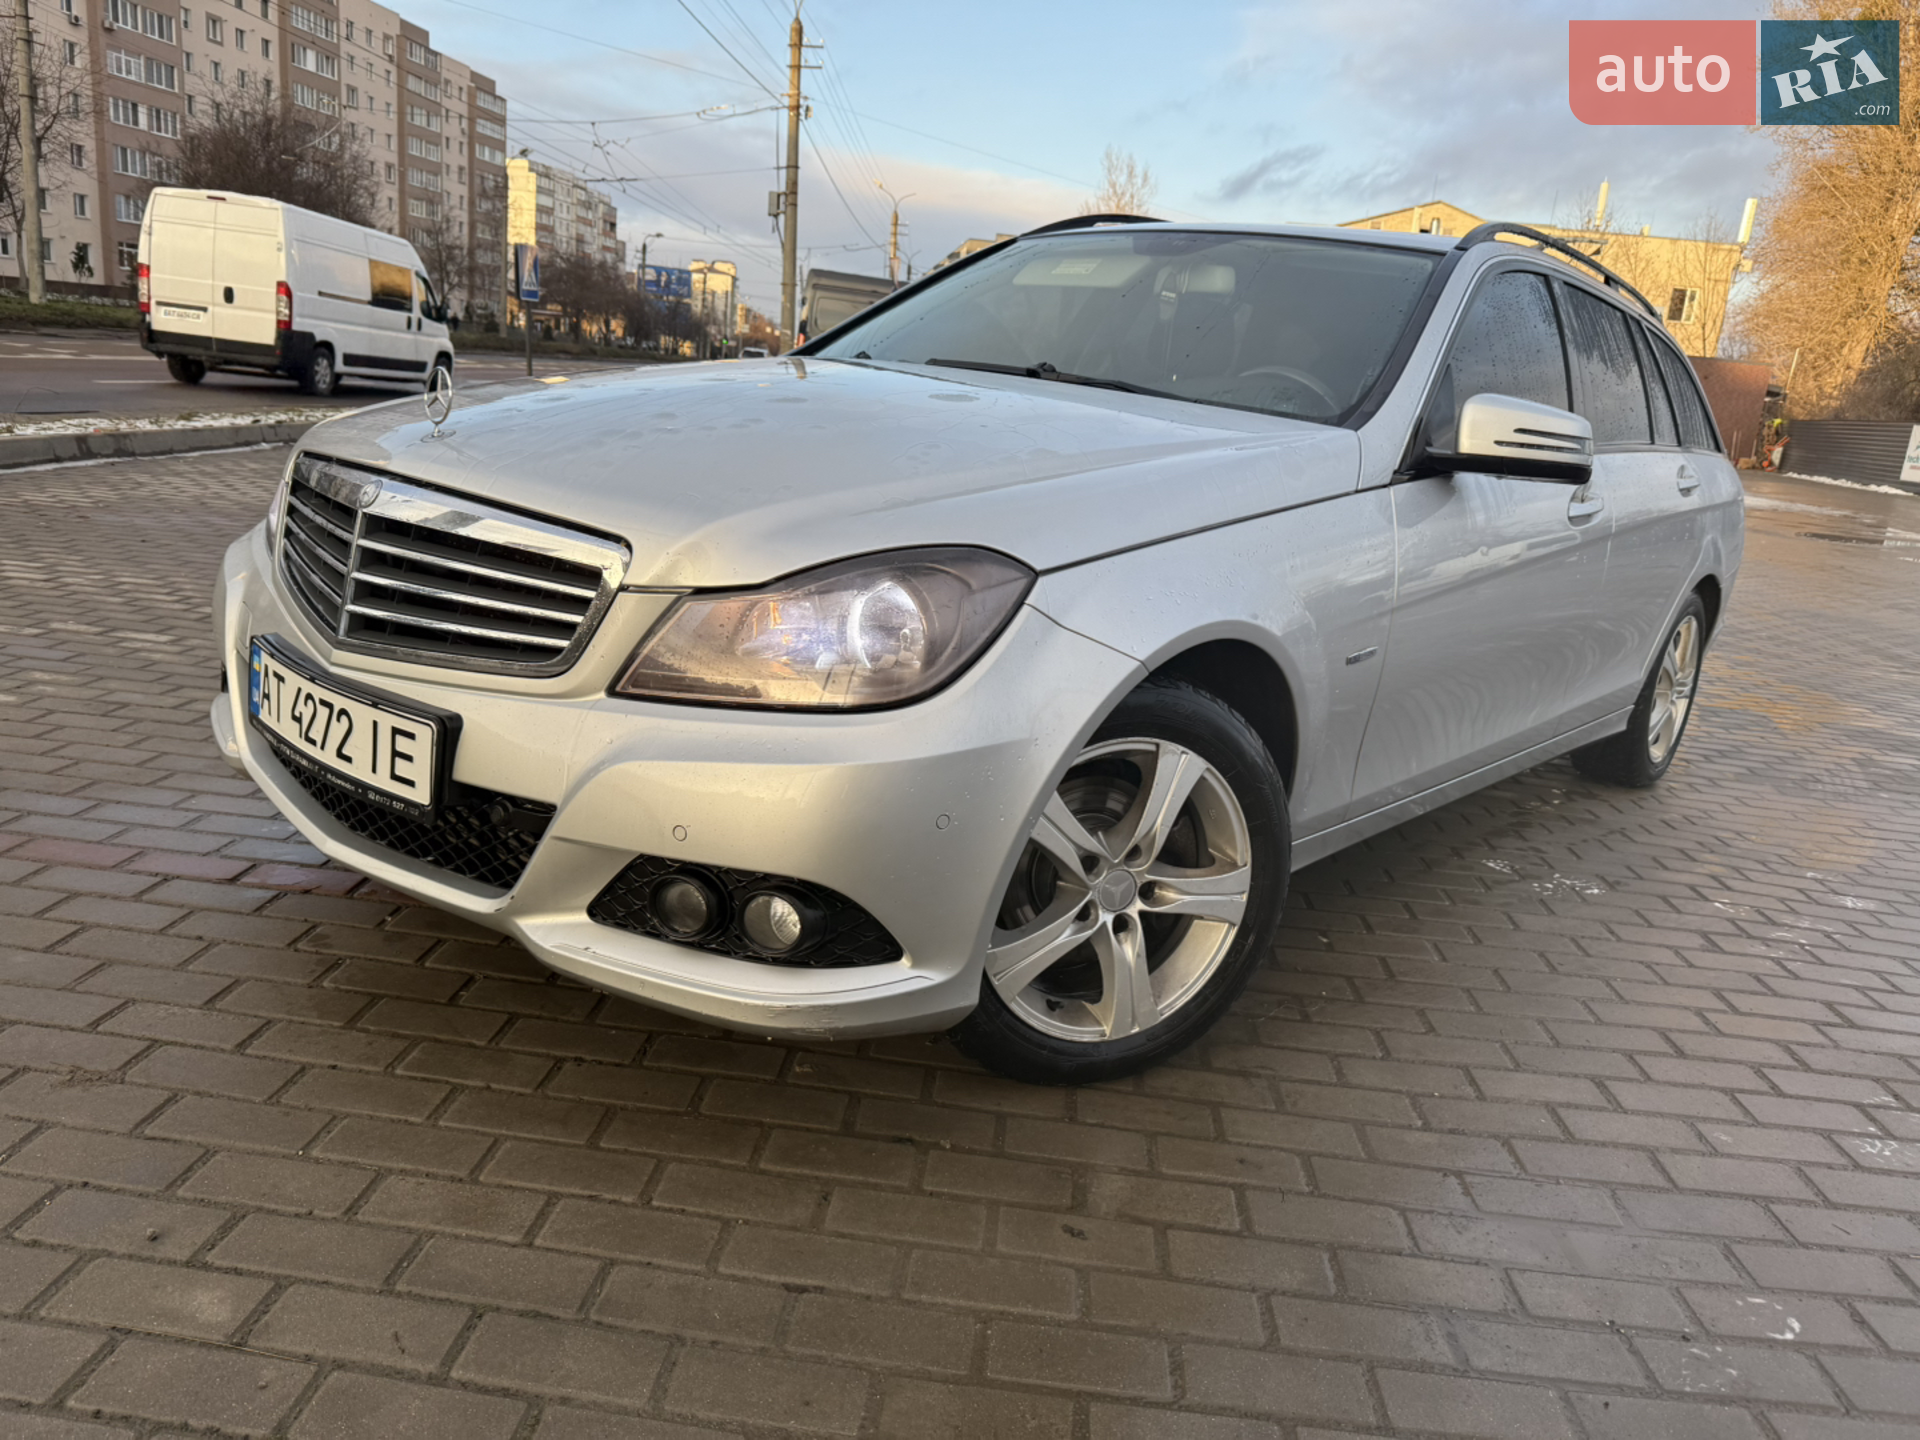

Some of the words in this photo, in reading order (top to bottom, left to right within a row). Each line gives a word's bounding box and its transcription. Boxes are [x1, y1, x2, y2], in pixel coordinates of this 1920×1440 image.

[261, 663, 285, 724] AT
[291, 686, 354, 765] 4272
[371, 719, 417, 789] IE
